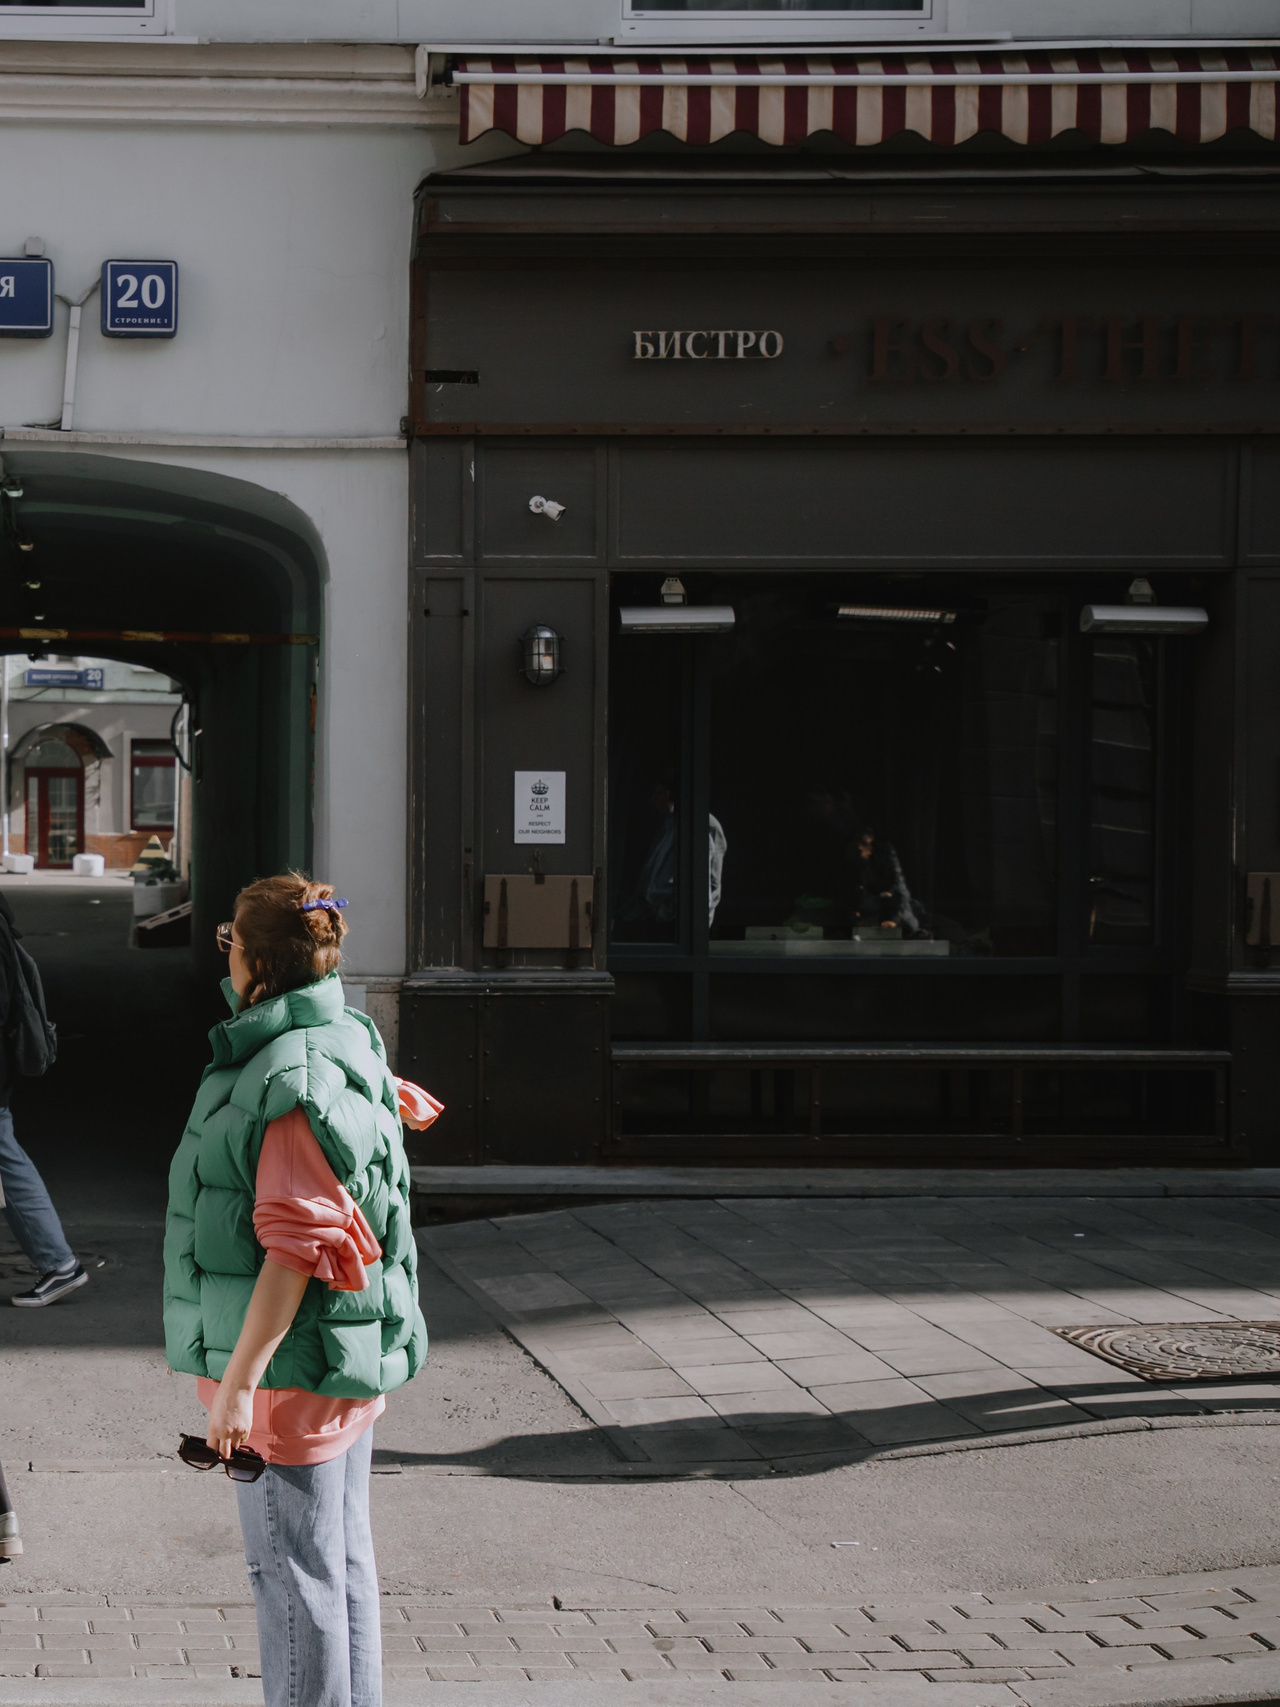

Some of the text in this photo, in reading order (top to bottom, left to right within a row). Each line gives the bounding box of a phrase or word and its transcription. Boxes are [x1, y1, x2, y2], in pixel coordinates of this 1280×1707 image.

[116, 274, 166, 309] 20
[633, 328, 784, 360] БИСТРО
[86, 669, 102, 681] 20
